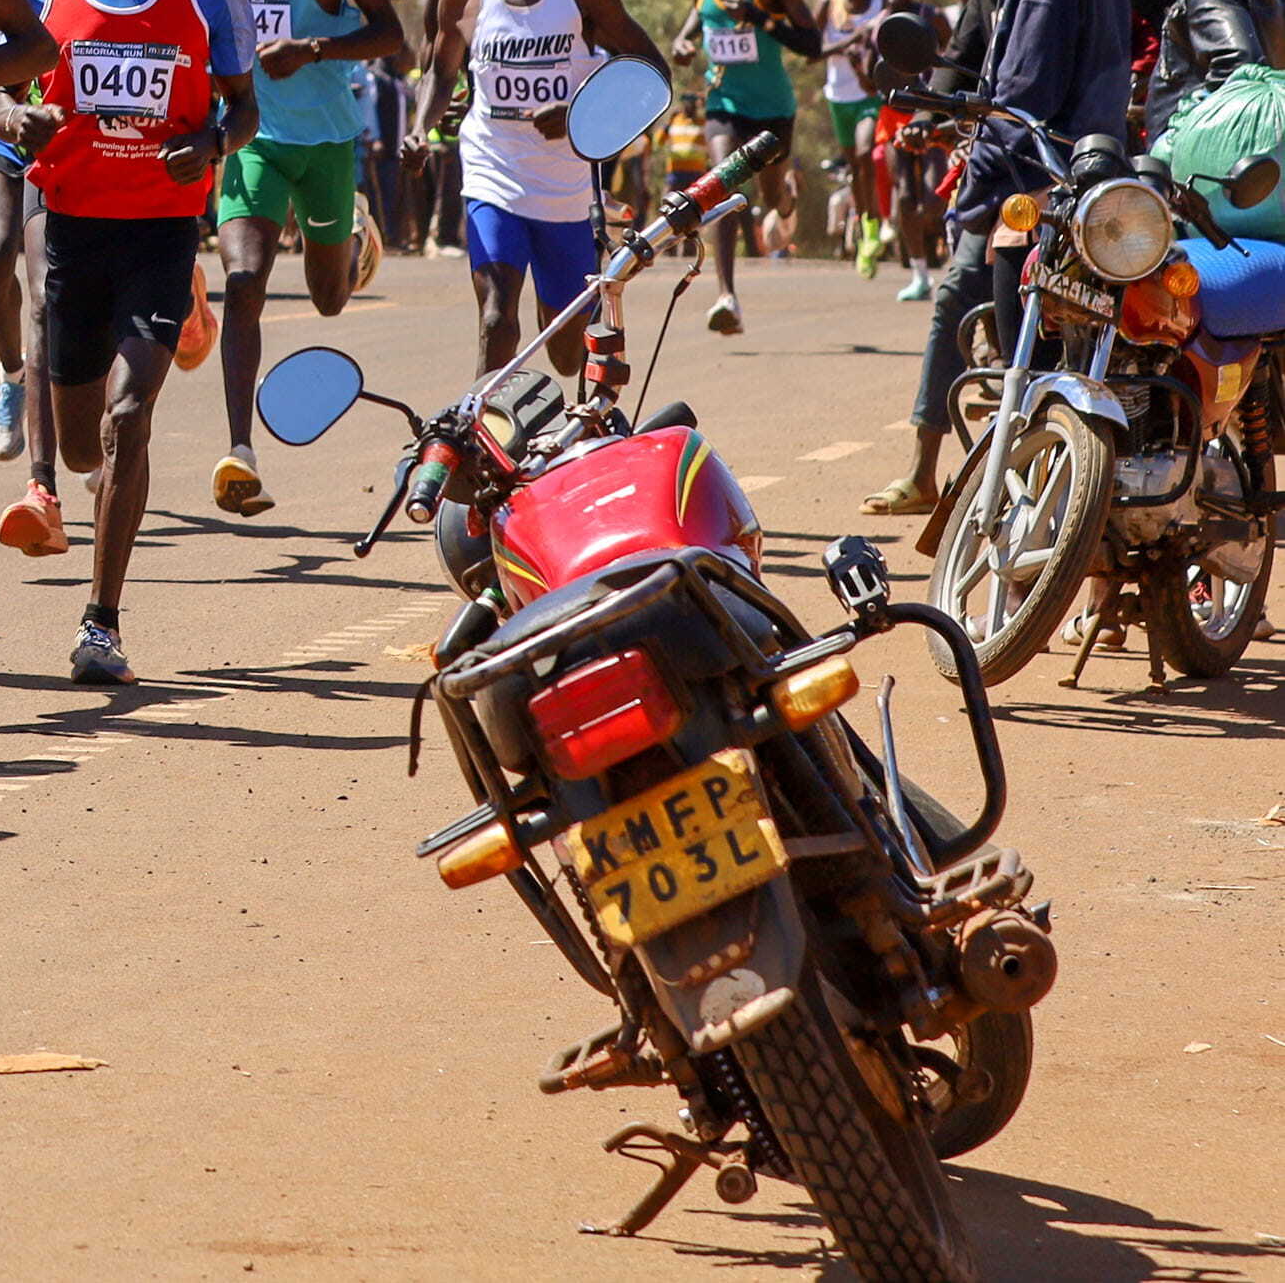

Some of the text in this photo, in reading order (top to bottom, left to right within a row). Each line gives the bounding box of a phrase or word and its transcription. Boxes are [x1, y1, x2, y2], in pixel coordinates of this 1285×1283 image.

[255, 9, 285, 35] 47
[73, 46, 144, 58] MEMORIAL RUN
[482, 33, 575, 62] OLYMPIKUS
[80, 63, 169, 100] 0405
[495, 74, 569, 103] 0960
[92, 140, 126, 152] Running
[126, 143, 139, 152] for
[102, 150, 115, 158] for
[115, 150, 129, 158] the
[130, 151, 144, 160] girl
[586, 776, 729, 874] KMFP
[604, 829, 760, 925] 703L
